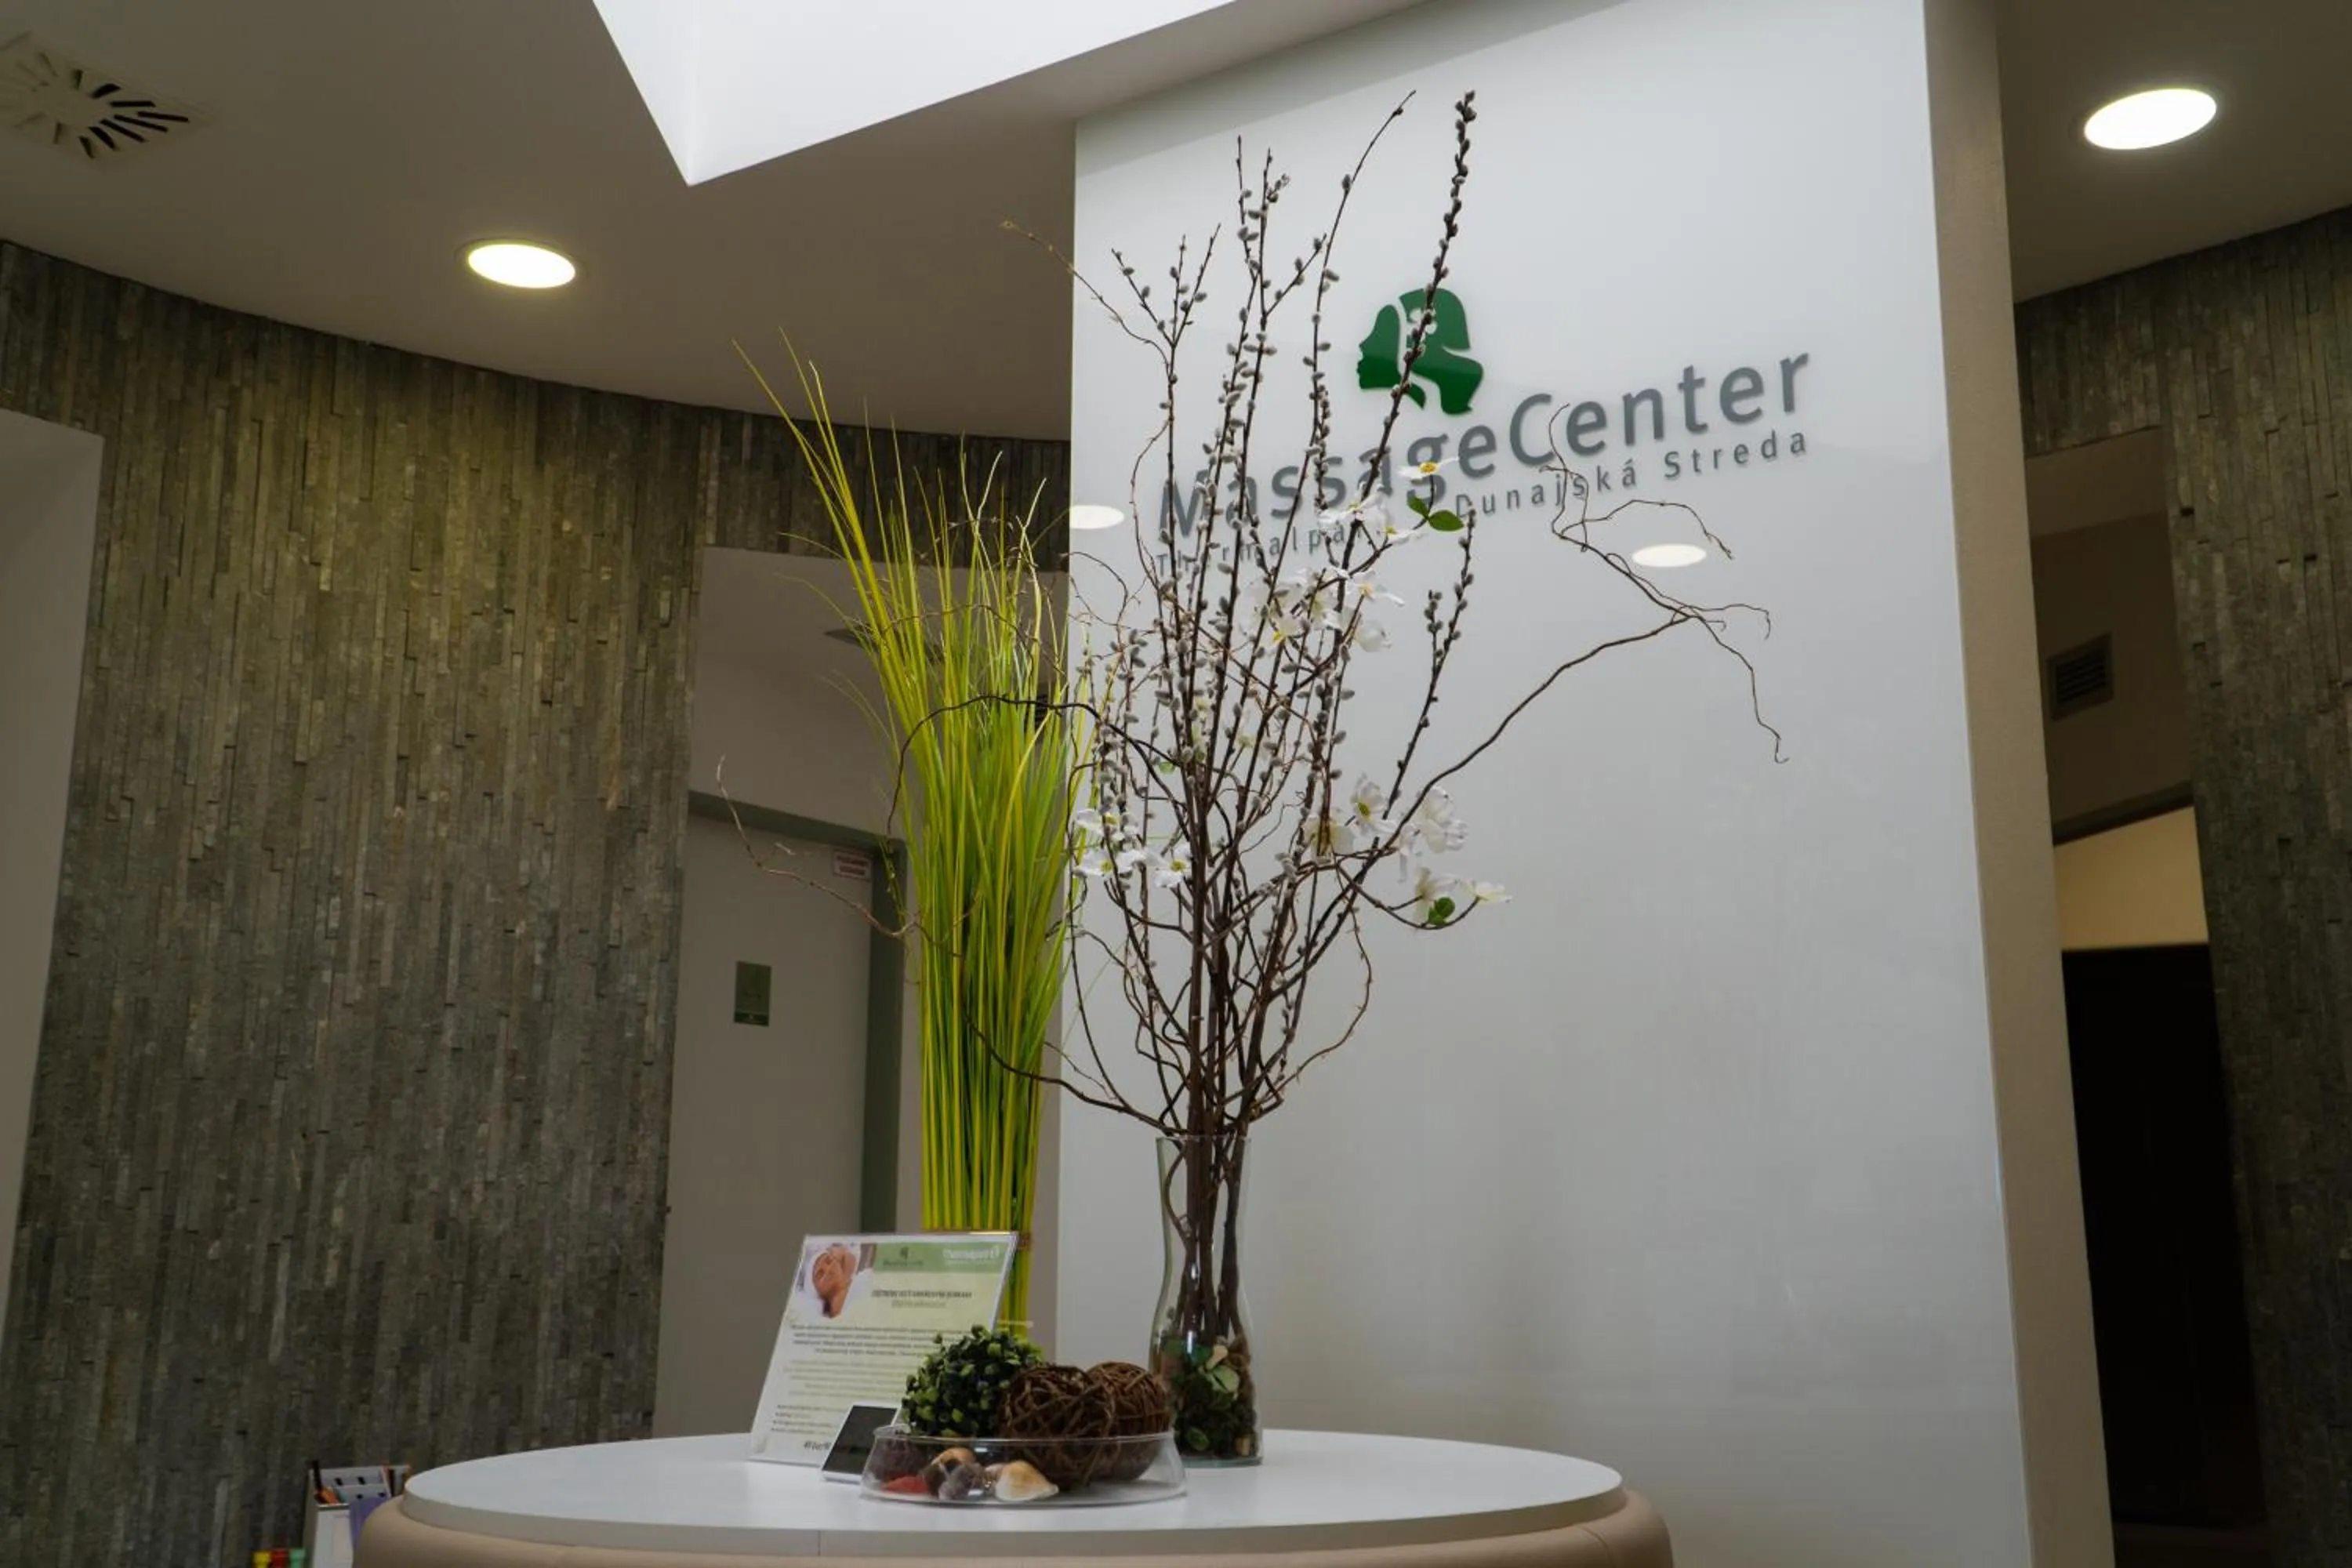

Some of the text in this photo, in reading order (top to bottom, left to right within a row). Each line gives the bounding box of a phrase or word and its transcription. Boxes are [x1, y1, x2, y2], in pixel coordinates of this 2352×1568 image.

[1159, 352, 1809, 539] MassageCenter
[1455, 458, 1637, 518] Dunajská
[1664, 430, 1807, 479] Streda
